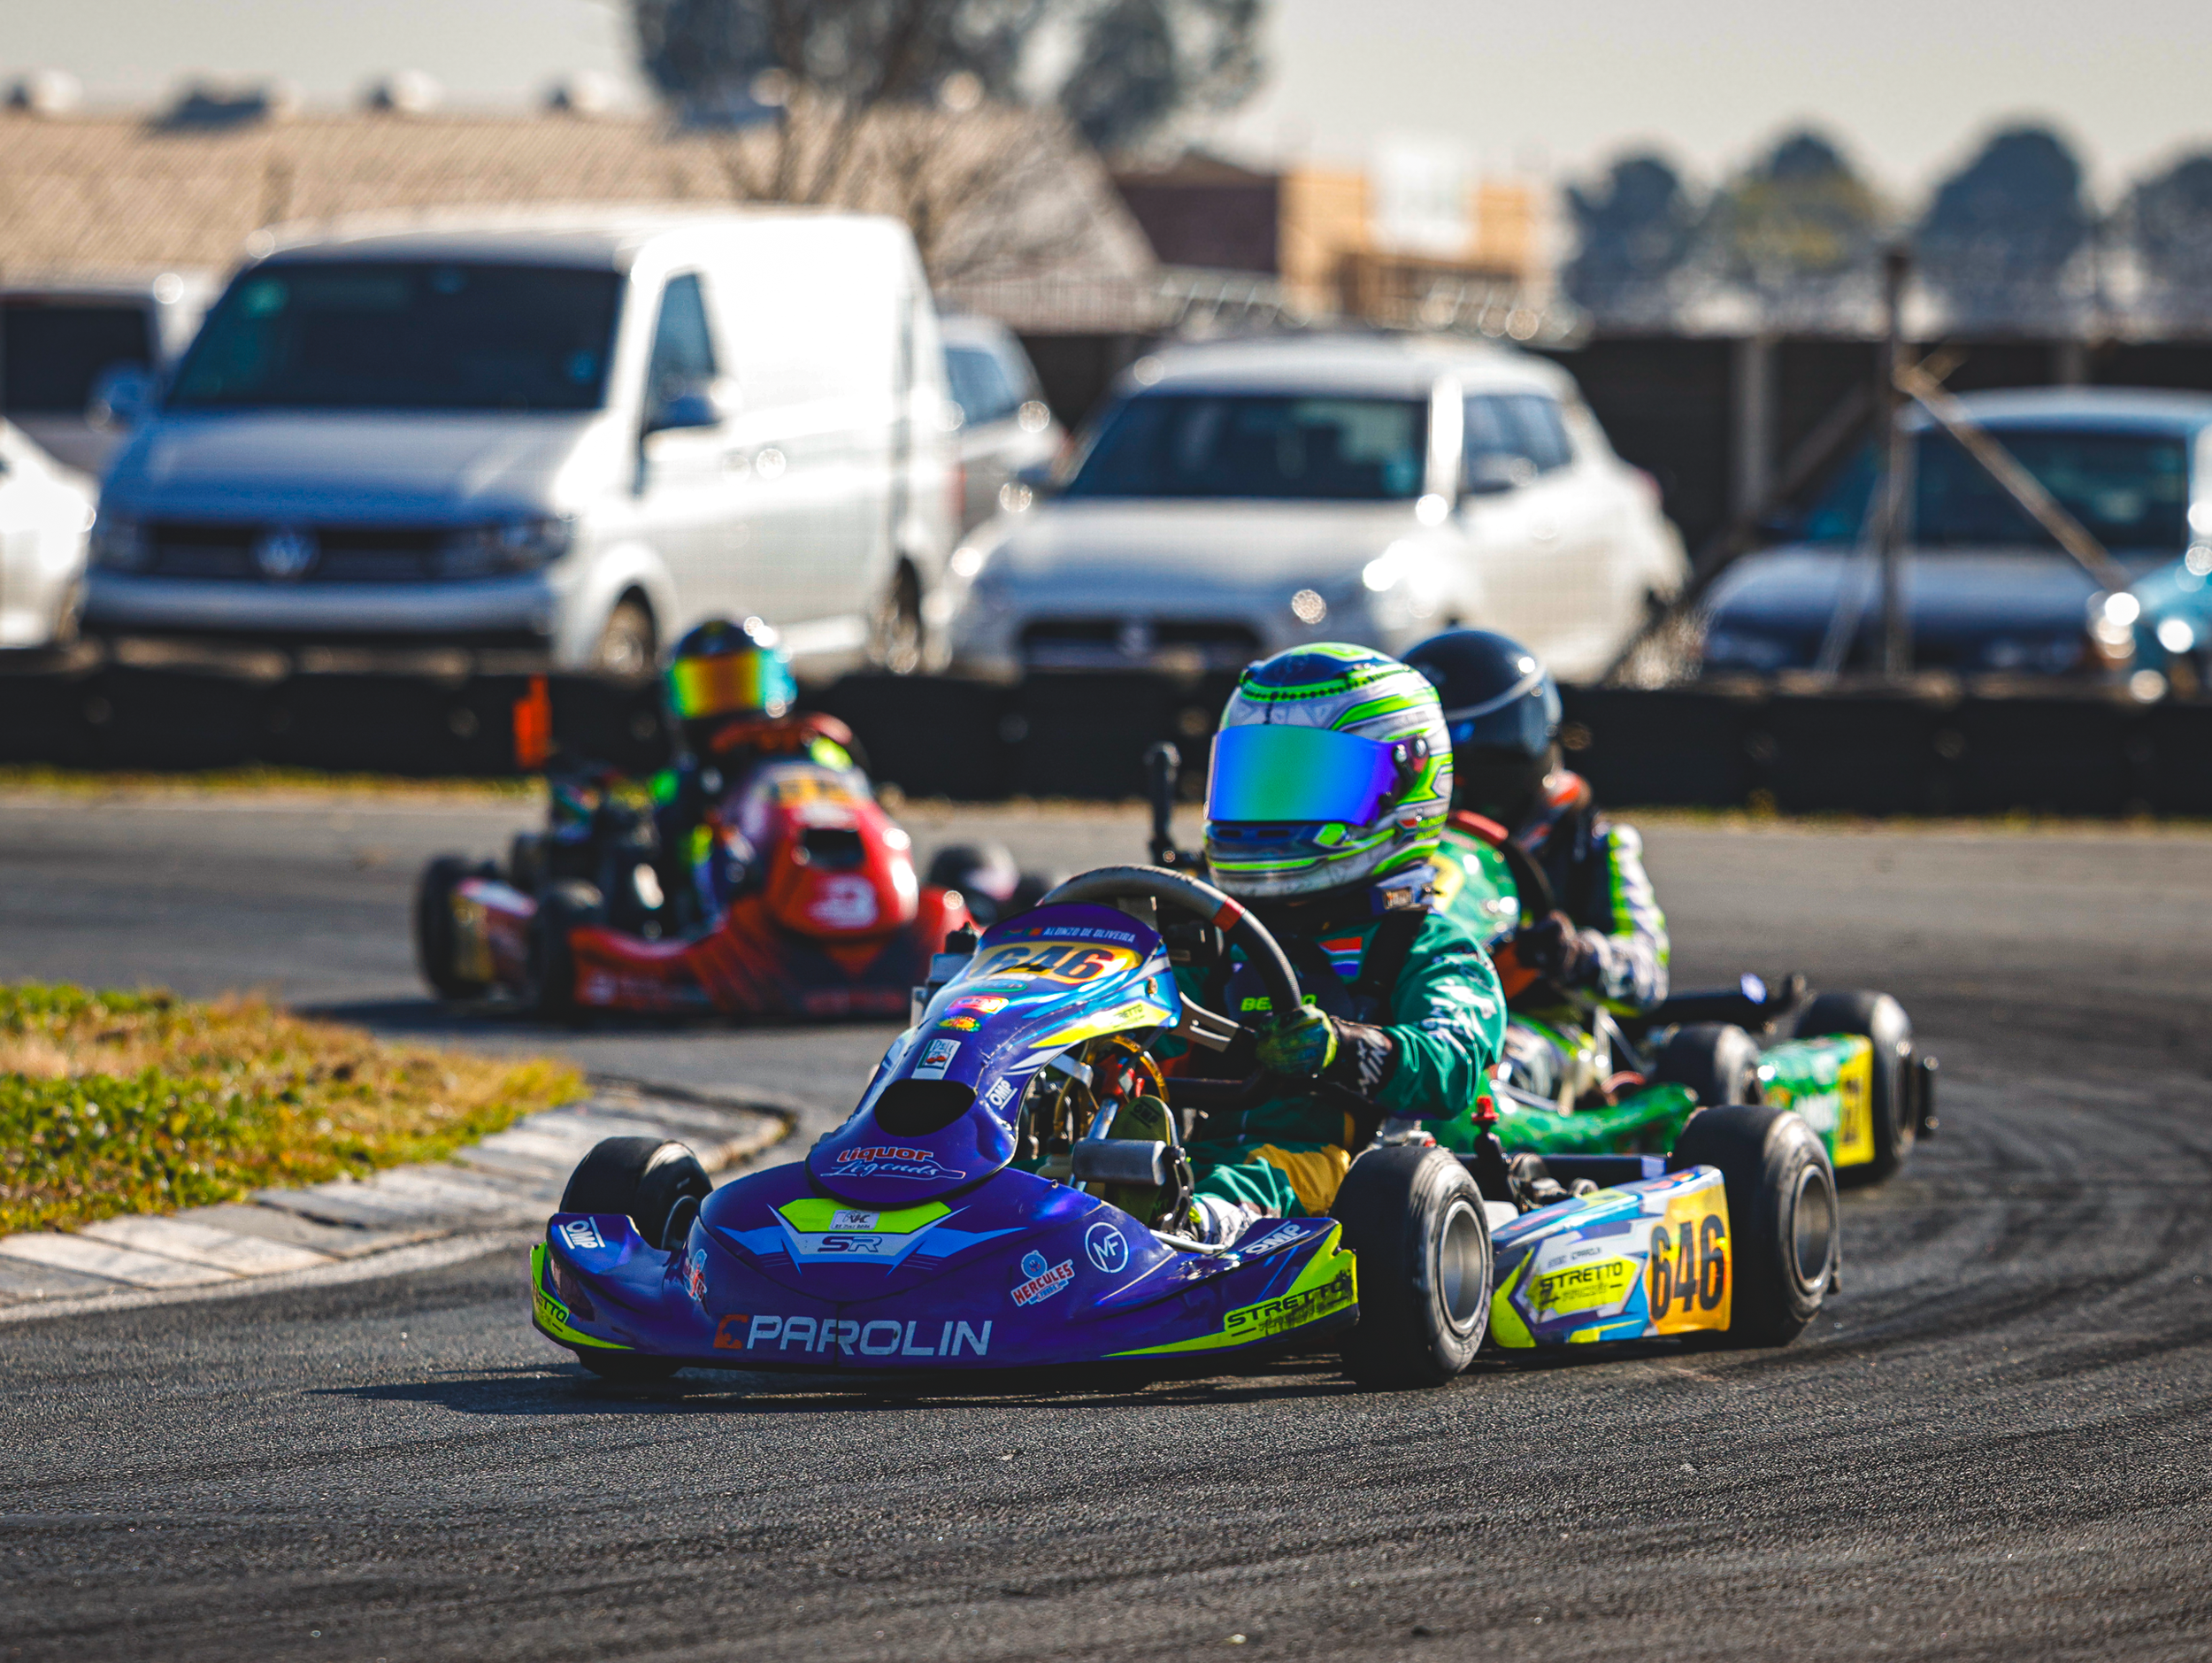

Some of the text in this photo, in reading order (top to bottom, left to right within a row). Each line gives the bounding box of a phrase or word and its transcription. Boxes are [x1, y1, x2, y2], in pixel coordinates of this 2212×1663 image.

[1042, 927, 1135, 943] ALONZO DE OLIVEIRA
[969, 945, 1115, 980] 646
[989, 1079, 1014, 1107] OMP
[820, 1159, 941, 1177] Legends
[837, 1146, 933, 1163] Liquor
[565, 1220, 599, 1249] OMP
[818, 1236, 883, 1252] SR
[1245, 1223, 1302, 1255] OMP
[1540, 1261, 1623, 1294] STRETTO
[1651, 1213, 1725, 1320] 646
[1012, 1262, 1074, 1305] HERCULES
[1227, 1280, 1345, 1328] STRETTO
[747, 1314, 993, 1357] PAROLIN
